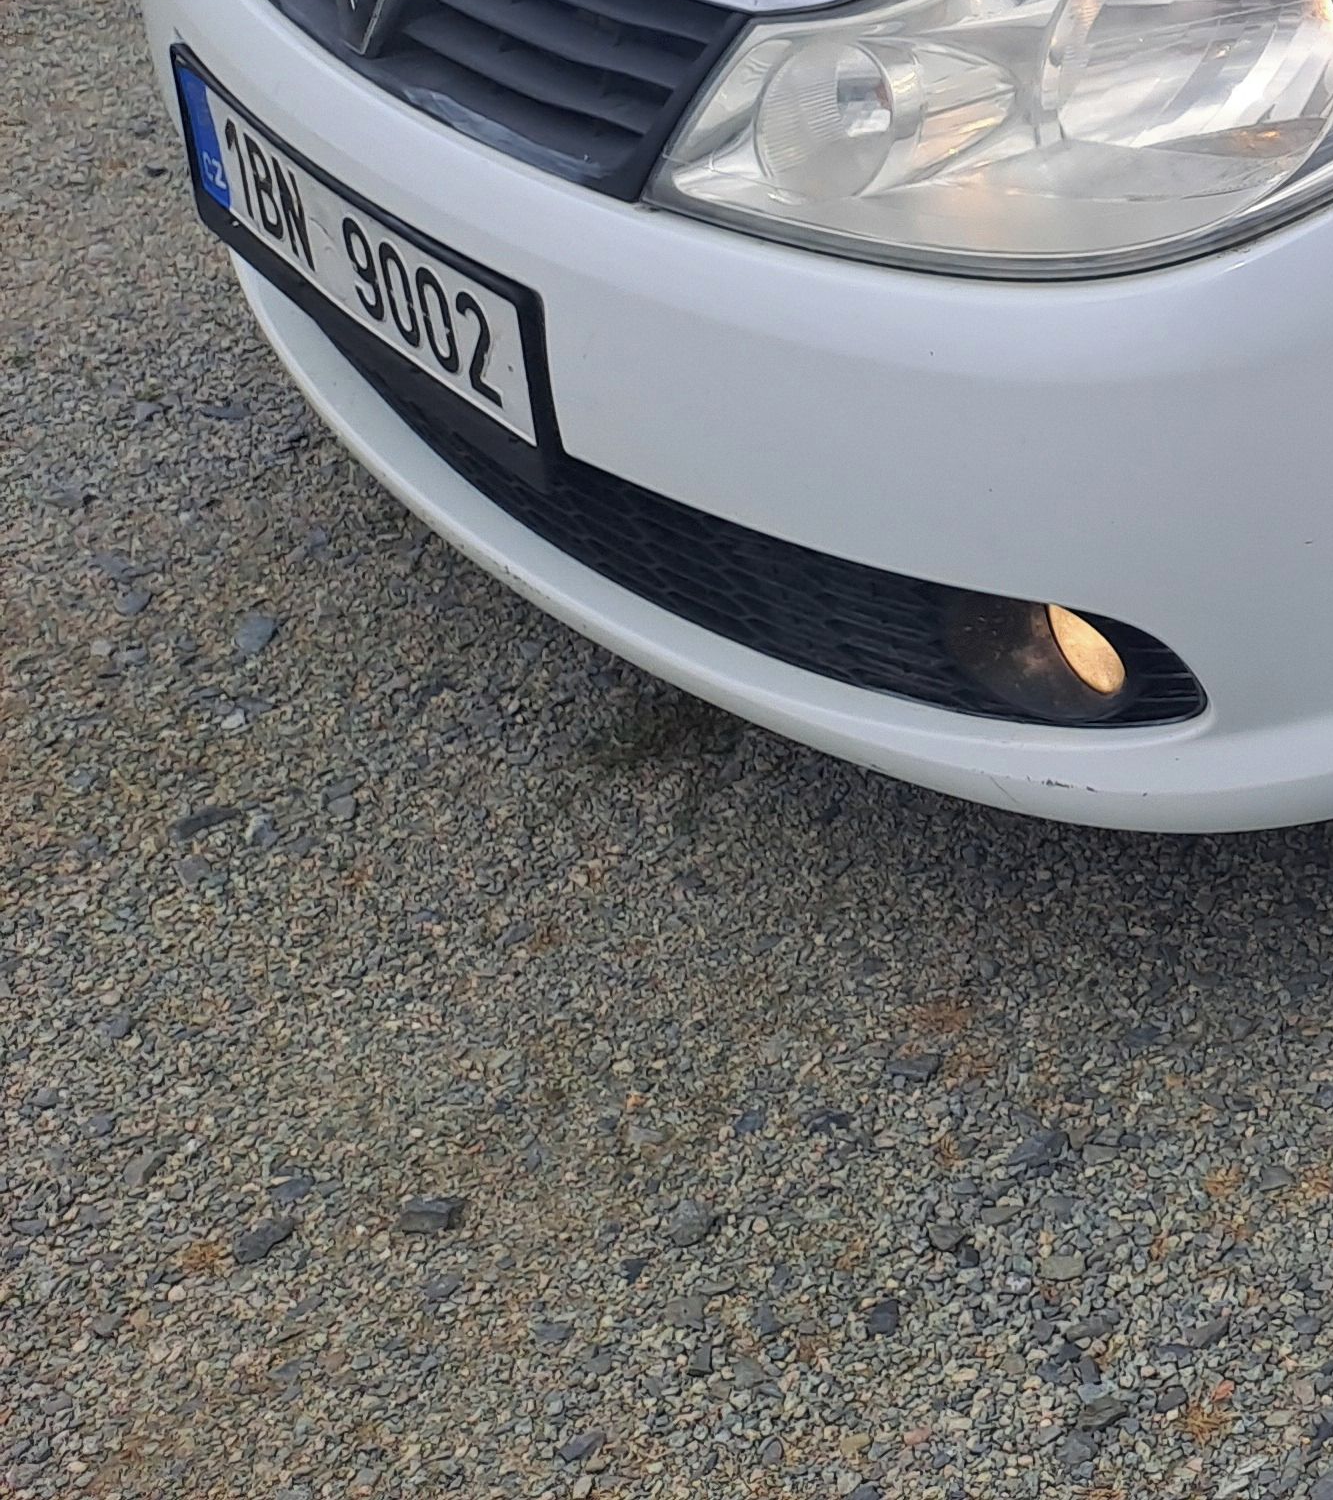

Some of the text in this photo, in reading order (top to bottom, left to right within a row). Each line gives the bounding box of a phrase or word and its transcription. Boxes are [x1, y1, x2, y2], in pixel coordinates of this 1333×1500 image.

[201, 152, 229, 190] CZ
[224, 117, 505, 411] 1BN 9002
